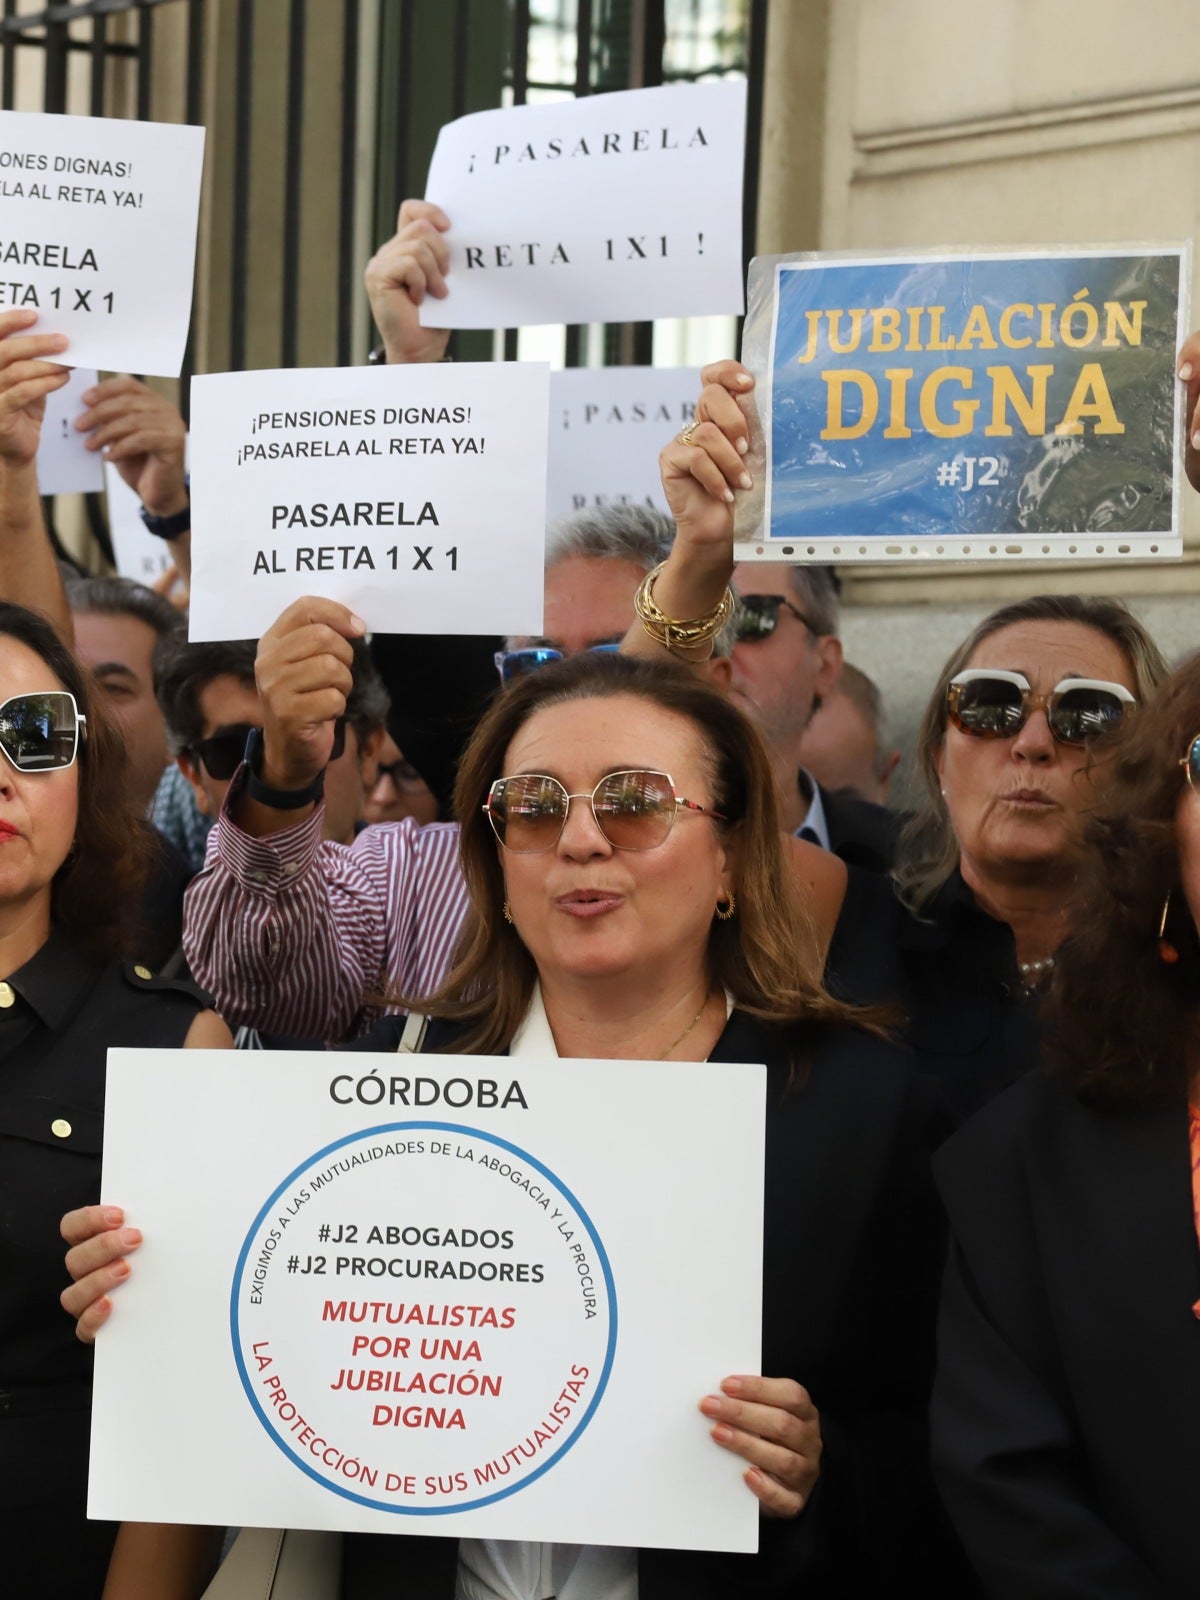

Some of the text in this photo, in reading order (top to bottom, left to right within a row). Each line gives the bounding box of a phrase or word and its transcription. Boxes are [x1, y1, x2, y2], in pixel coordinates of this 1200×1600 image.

[493, 126, 709, 165] PASARELA
[54, 157, 132, 178] DIGNAS!
[28, 184, 52, 200] AL
[57, 186, 107, 205] RETA
[113, 191, 143, 208] YA!
[465, 242, 570, 269] RETA
[606, 235, 668, 260] 1X1
[50, 287, 61, 309] 1
[73, 289, 92, 312] X
[103, 292, 115, 314] 1
[798, 288, 1148, 363] JUBILACIÓN
[820, 363, 1125, 440] DIGNA
[252, 406, 472, 434] ¡PENSIONES DIGNAS!
[238, 437, 485, 466] ¡PASARELA AL RETA YA!
[936, 457, 1000, 491] #J2
[272, 501, 440, 529] PASARELA
[253, 546, 457, 575] AL RETA 1 X 1
[329, 1070, 529, 1109] CÓRDOBA
[250, 1141, 597, 1320] EXIGIMOS A LAS MUTUALIDADES DE LA ABOGACIA Y LA PROCURA
[317, 1225, 514, 1249] #J2 ABOGADOS
[286, 1256, 545, 1283] #J2 PROCURADORES
[321, 1301, 516, 1329] MUTUALISTAS
[351, 1337, 482, 1362] POR UNA
[330, 1370, 502, 1397] JUBILACIÓN
[252, 1341, 589, 1496] LA PROTECCIÓN DE SUS MUTUALISTAS
[371, 1405, 466, 1430] DIGNA
